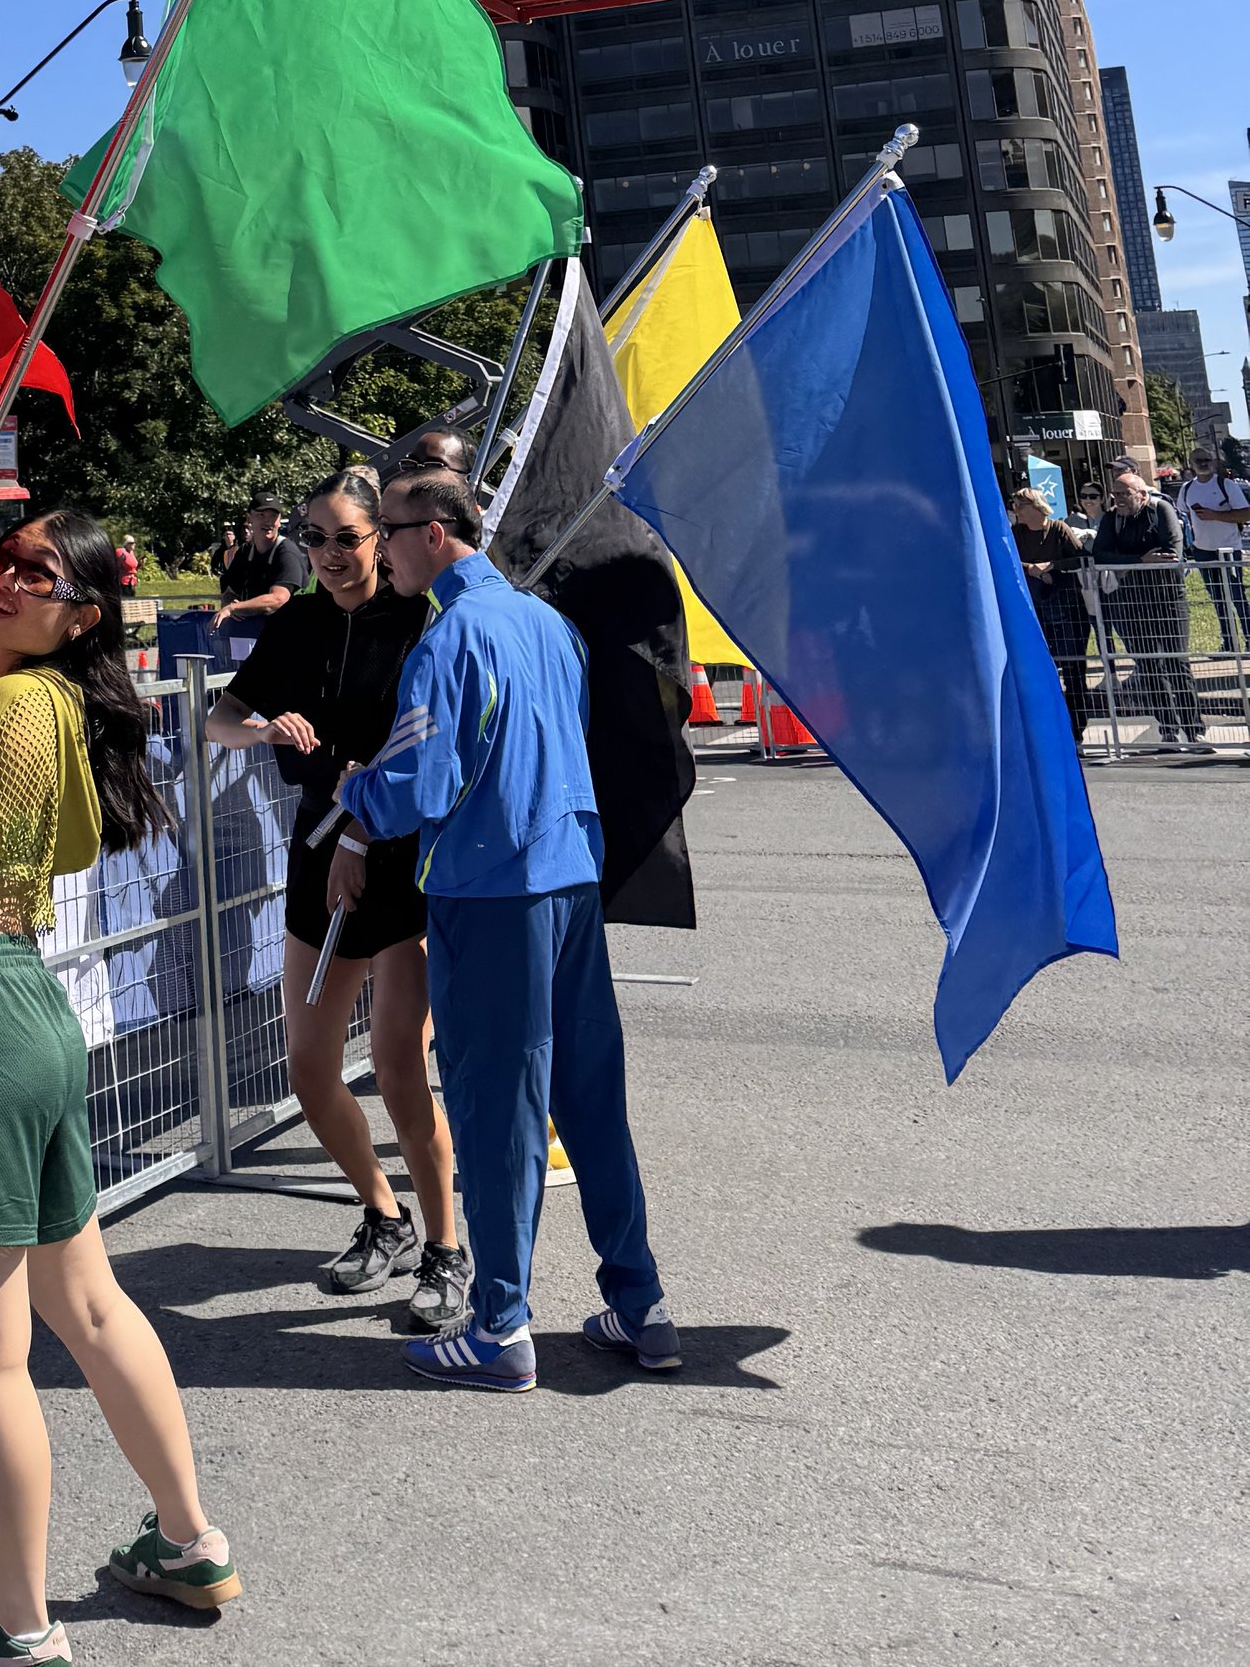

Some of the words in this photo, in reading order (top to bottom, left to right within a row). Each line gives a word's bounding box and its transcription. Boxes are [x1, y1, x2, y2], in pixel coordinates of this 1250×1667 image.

[704, 41, 724, 63] À
[732, 38, 801, 60] louer
[1041, 427, 1074, 440] louer
